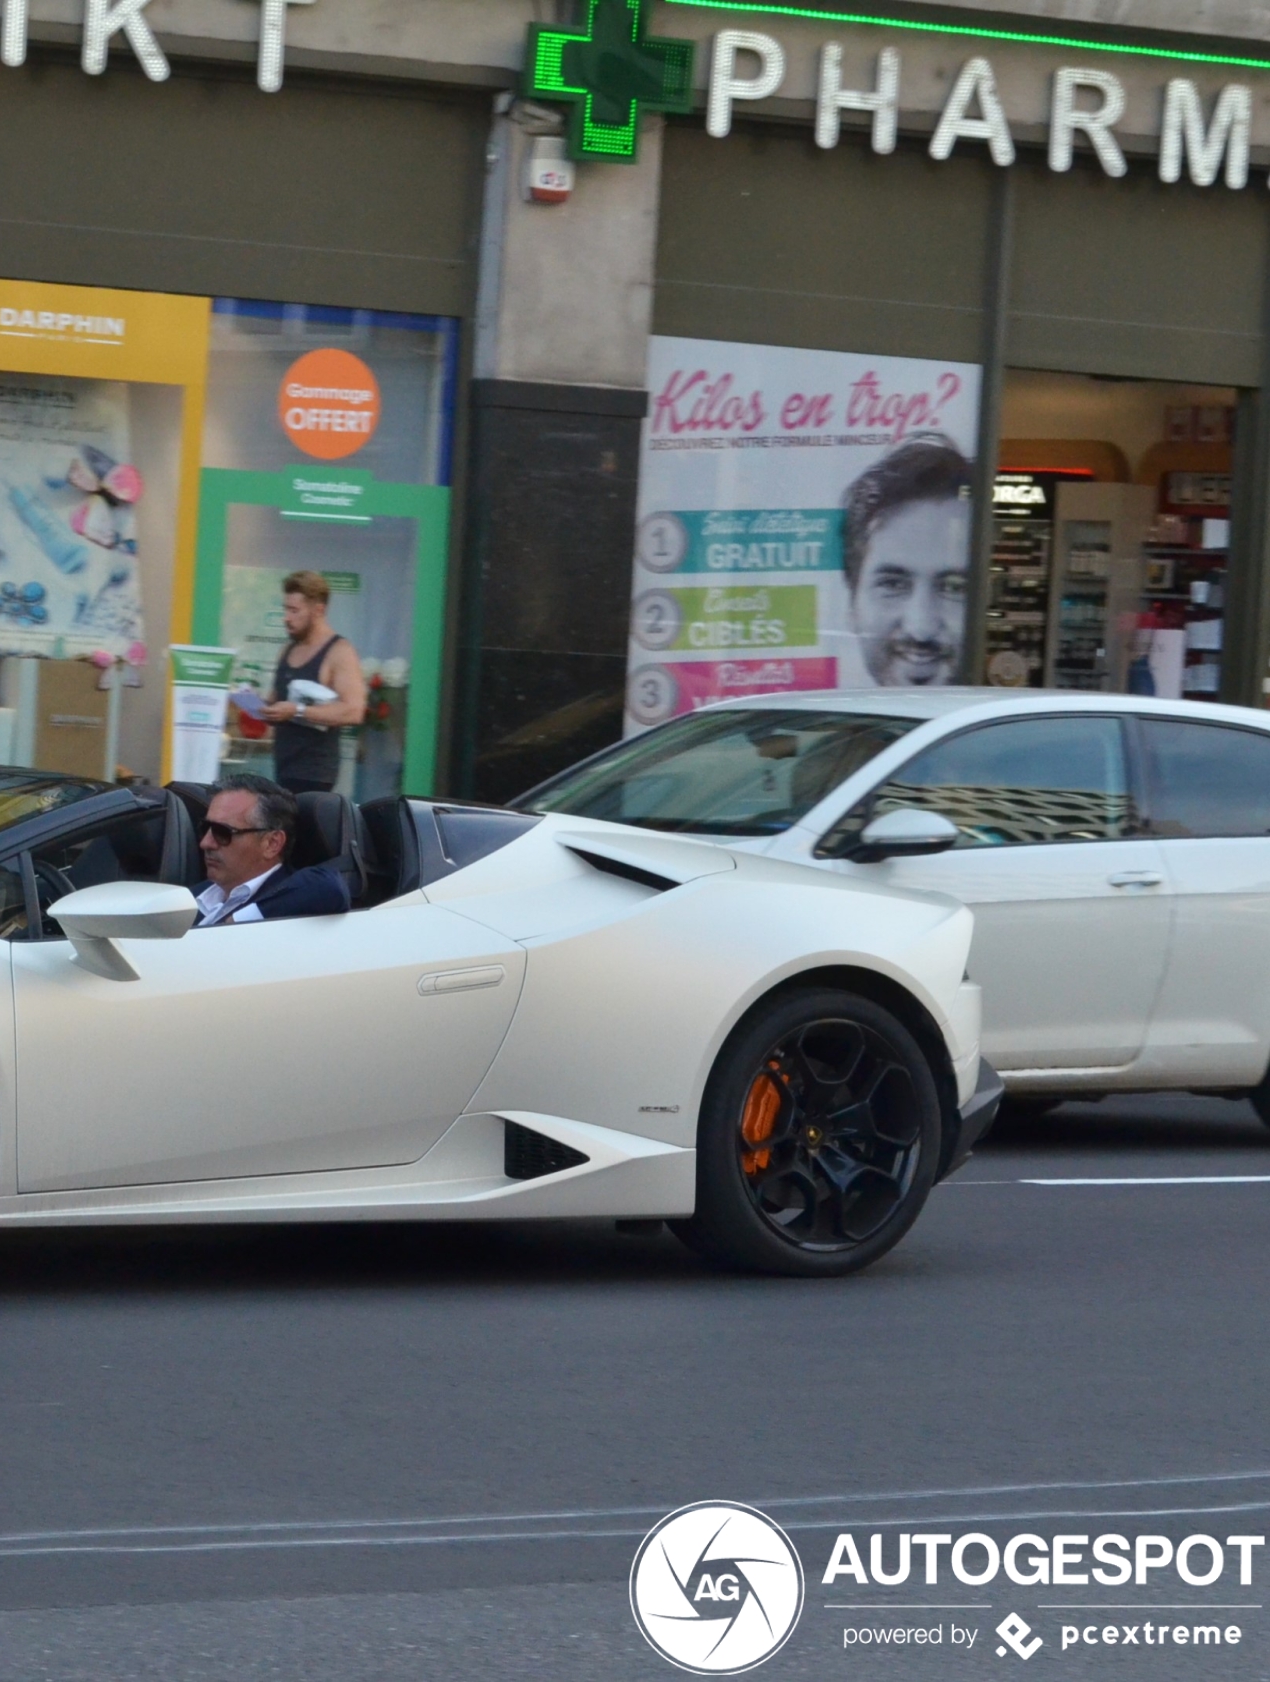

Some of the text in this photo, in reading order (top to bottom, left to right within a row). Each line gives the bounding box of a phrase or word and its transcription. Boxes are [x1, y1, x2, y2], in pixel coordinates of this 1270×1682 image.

[705, 28, 1270, 190] PHARM
[285, 407, 373, 433] OFFERT
[651, 370, 962, 444] Kilos en trop?
[651, 526, 669, 557] 1
[706, 542, 824, 569] GRATUIT
[646, 603, 665, 634] 2
[688, 614, 787, 647] CIBLÉS
[640, 679, 660, 708] 3
